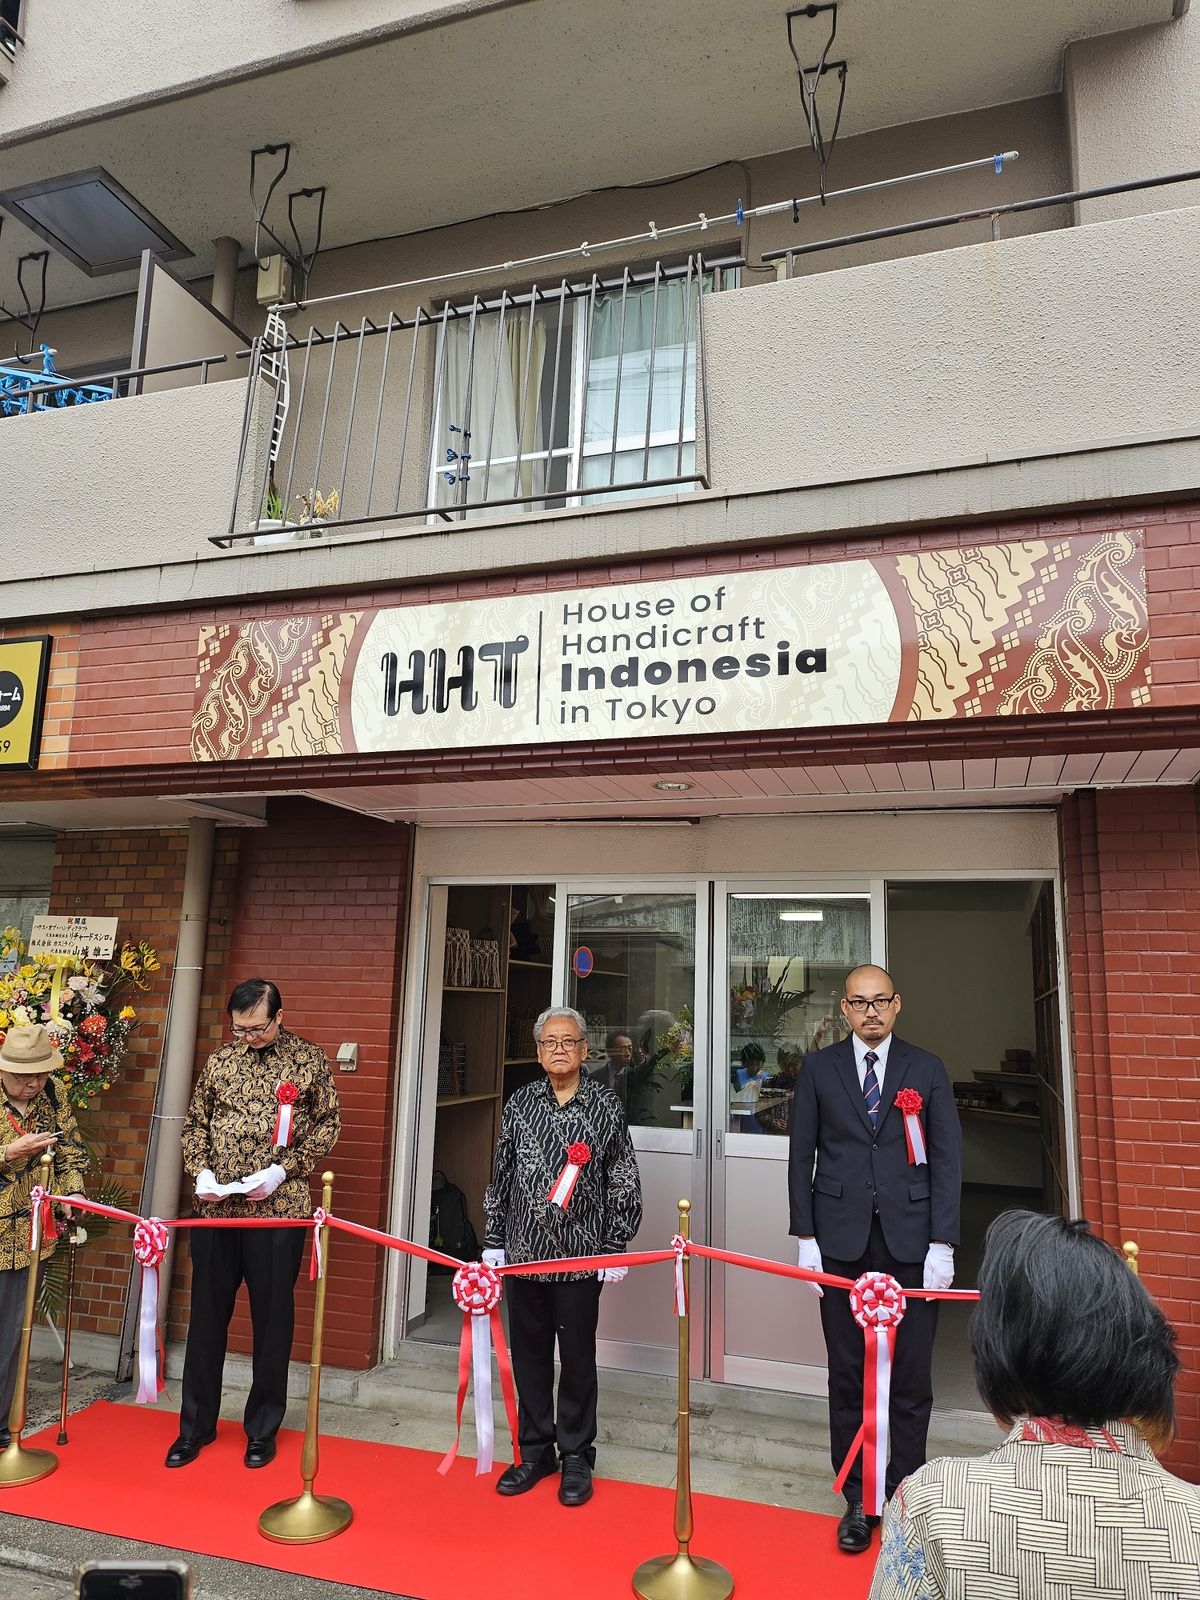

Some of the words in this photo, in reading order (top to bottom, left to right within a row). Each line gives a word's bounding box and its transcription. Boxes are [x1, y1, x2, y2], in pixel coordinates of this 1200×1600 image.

[563, 602, 676, 625] House
[690, 586, 727, 612] of
[562, 616, 765, 655] Handicraft
[380, 635, 530, 716] HHT
[561, 640, 828, 692] Indonesia
[560, 701, 590, 724] in
[605, 693, 717, 725] Tokyo
